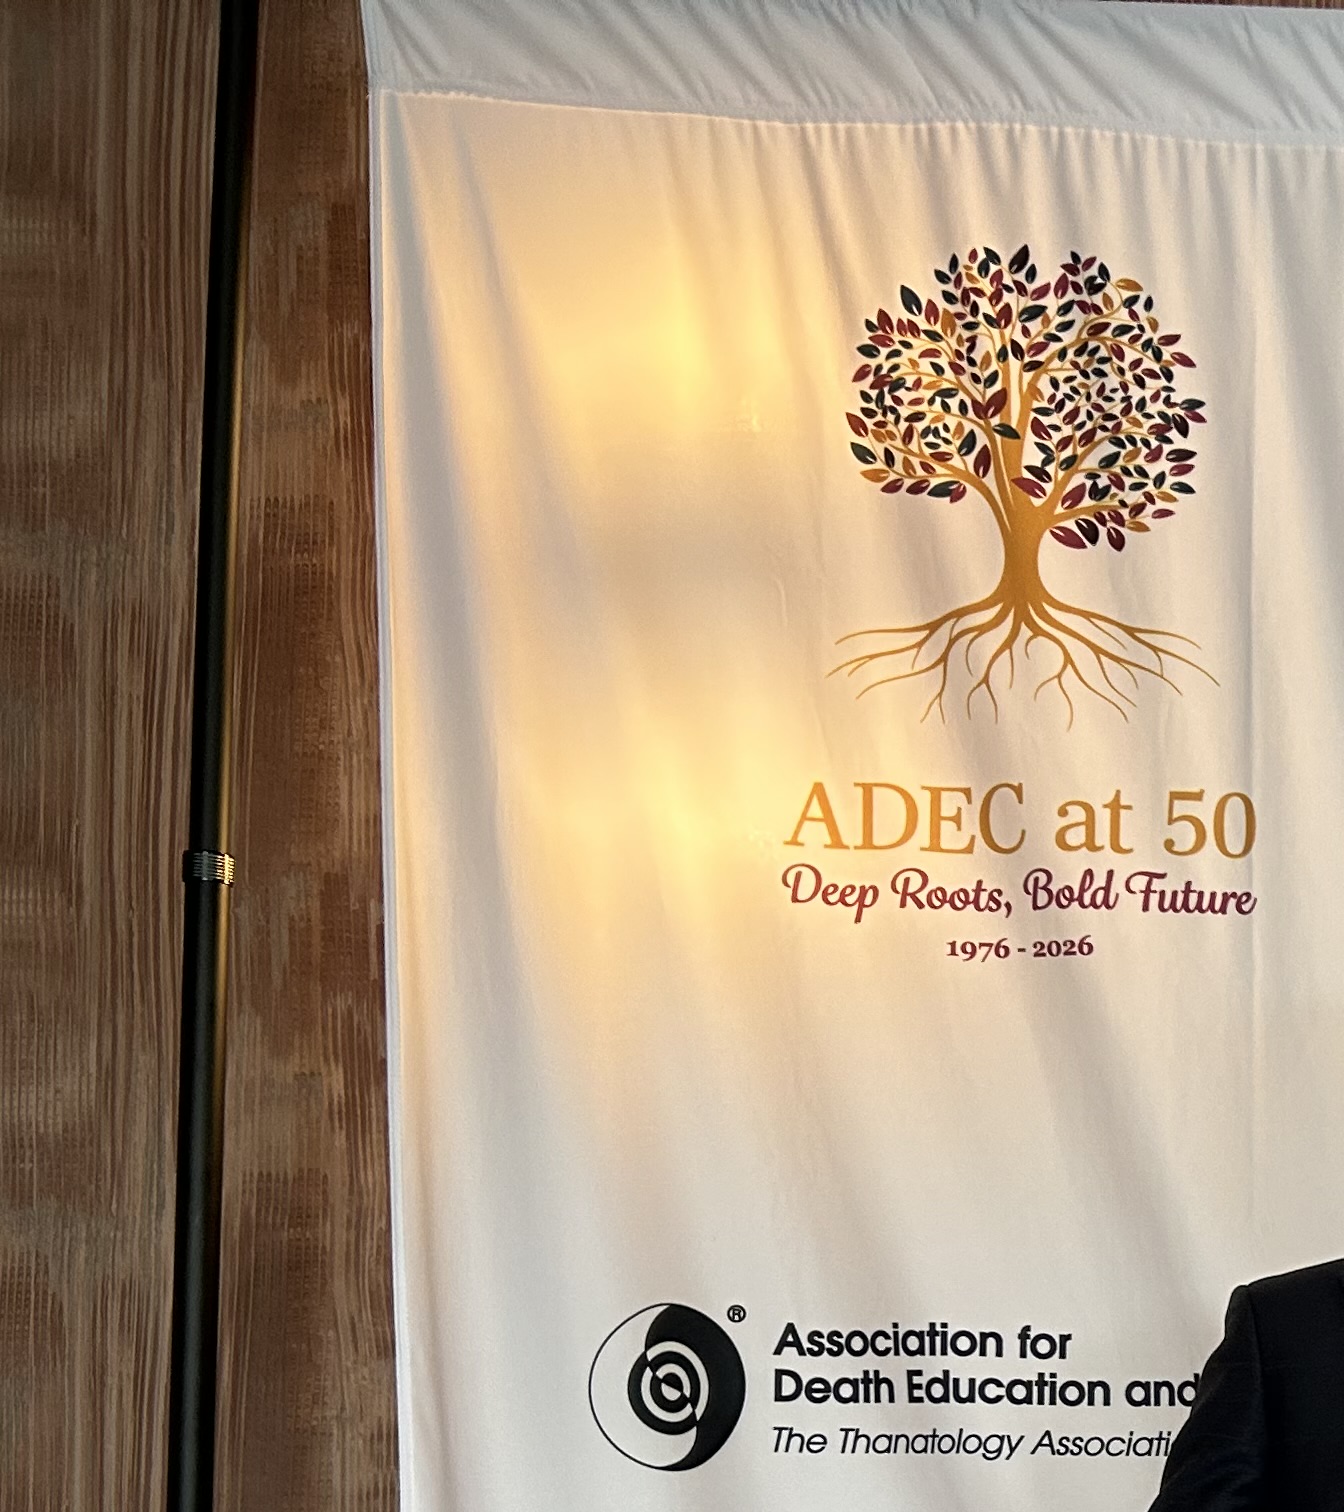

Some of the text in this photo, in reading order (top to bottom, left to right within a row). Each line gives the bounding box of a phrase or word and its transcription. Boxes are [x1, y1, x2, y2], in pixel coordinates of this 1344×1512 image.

[784, 782, 1256, 859] ADEC at 50
[782, 863, 1257, 924] Deep Roots, Bold Future
[947, 938, 1010, 962] 1976
[1033, 935, 1093, 957] 2026
[773, 1322, 1072, 1360] Association for
[774, 1368, 1200, 1407] Death Education and
[773, 1427, 1172, 1461] The Thanatology Associati
